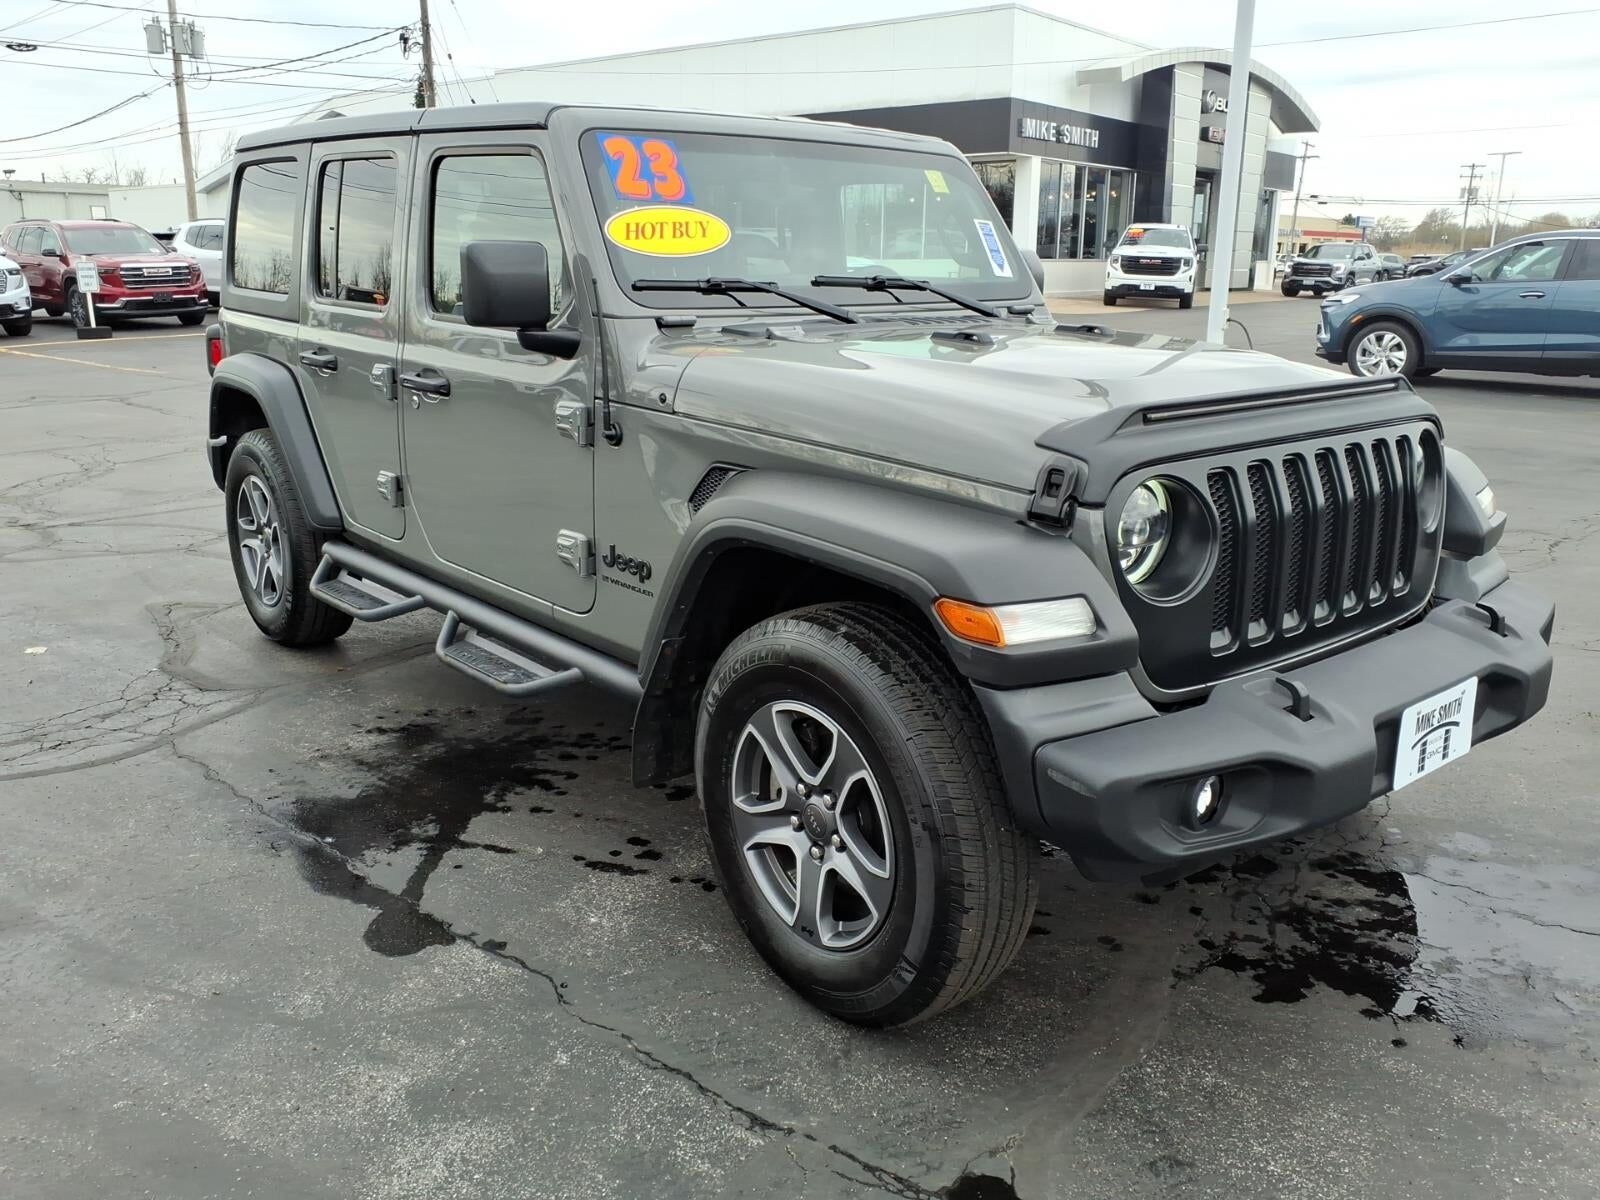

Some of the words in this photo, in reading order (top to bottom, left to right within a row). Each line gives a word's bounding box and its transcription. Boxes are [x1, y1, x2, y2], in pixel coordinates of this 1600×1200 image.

[1022, 117, 1057, 141] MIKE
[1062, 123, 1100, 148] SMITH
[603, 136, 685, 201] 23
[625, 220, 668, 241] HOT
[671, 220, 710, 239] BUY
[602, 543, 652, 584] Jeep
[609, 577, 654, 598] WRANGLER
[1414, 708, 1438, 736] MIKE
[1437, 696, 1464, 724] SMITH
